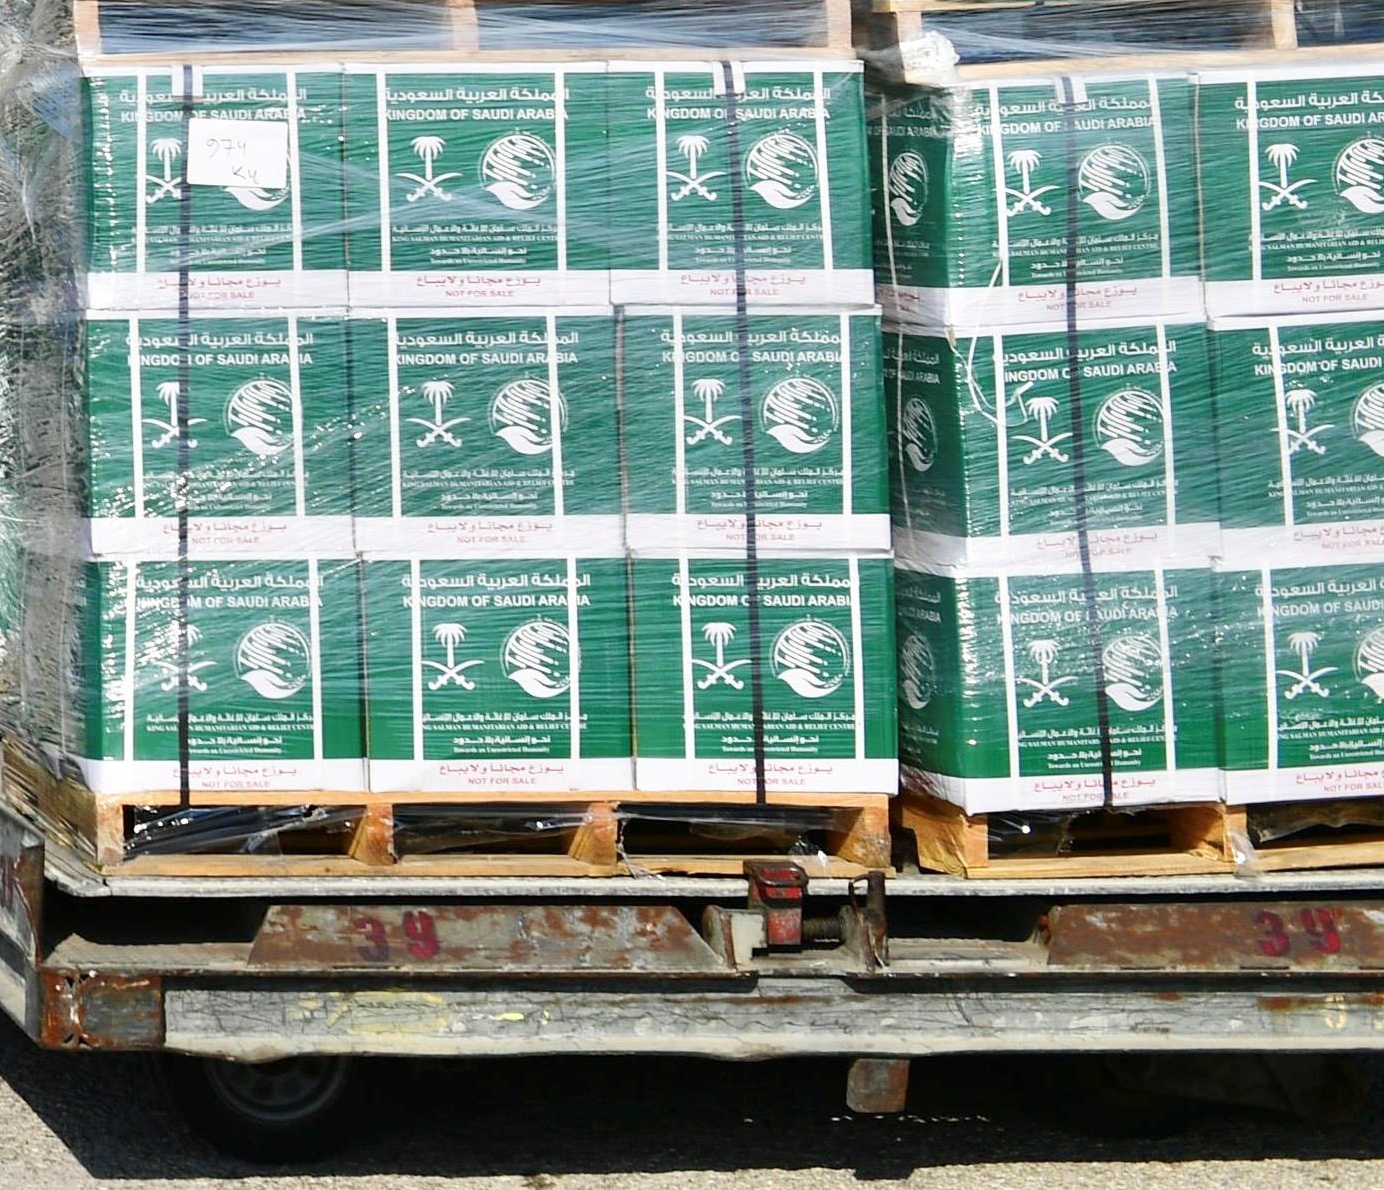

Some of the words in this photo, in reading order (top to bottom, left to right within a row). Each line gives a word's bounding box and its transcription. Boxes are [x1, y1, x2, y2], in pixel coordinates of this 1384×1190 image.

[455, 88, 507, 105] العربية
[450, 108, 469, 120] OF
[472, 108, 516, 121] SAUDI
[1303, 114, 1321, 126] OF
[1324, 113, 1366, 125] SAUDI
[445, 289, 467, 297] NOT
[468, 289, 487, 297] FOR
[490, 289, 516, 297] SALE
[1302, 294, 1322, 303] NOT
[1323, 294, 1343, 303] FOR
[1345, 293, 1368, 302] SALE
[465, 331, 516, 348] العربية
[459, 354, 480, 365] OF
[482, 353, 524, 365] SAUDI
[1321, 360, 1339, 372] OF
[1342, 357, 1382, 370] SAUDI
[477, 572, 529, 590] العربية
[471, 595, 490, 607] OF
[493, 595, 536, 607] SAUDI
[468, 777, 487, 786] NOT
[490, 777, 510, 786] FOR
[512, 777, 537, 786] SALE
